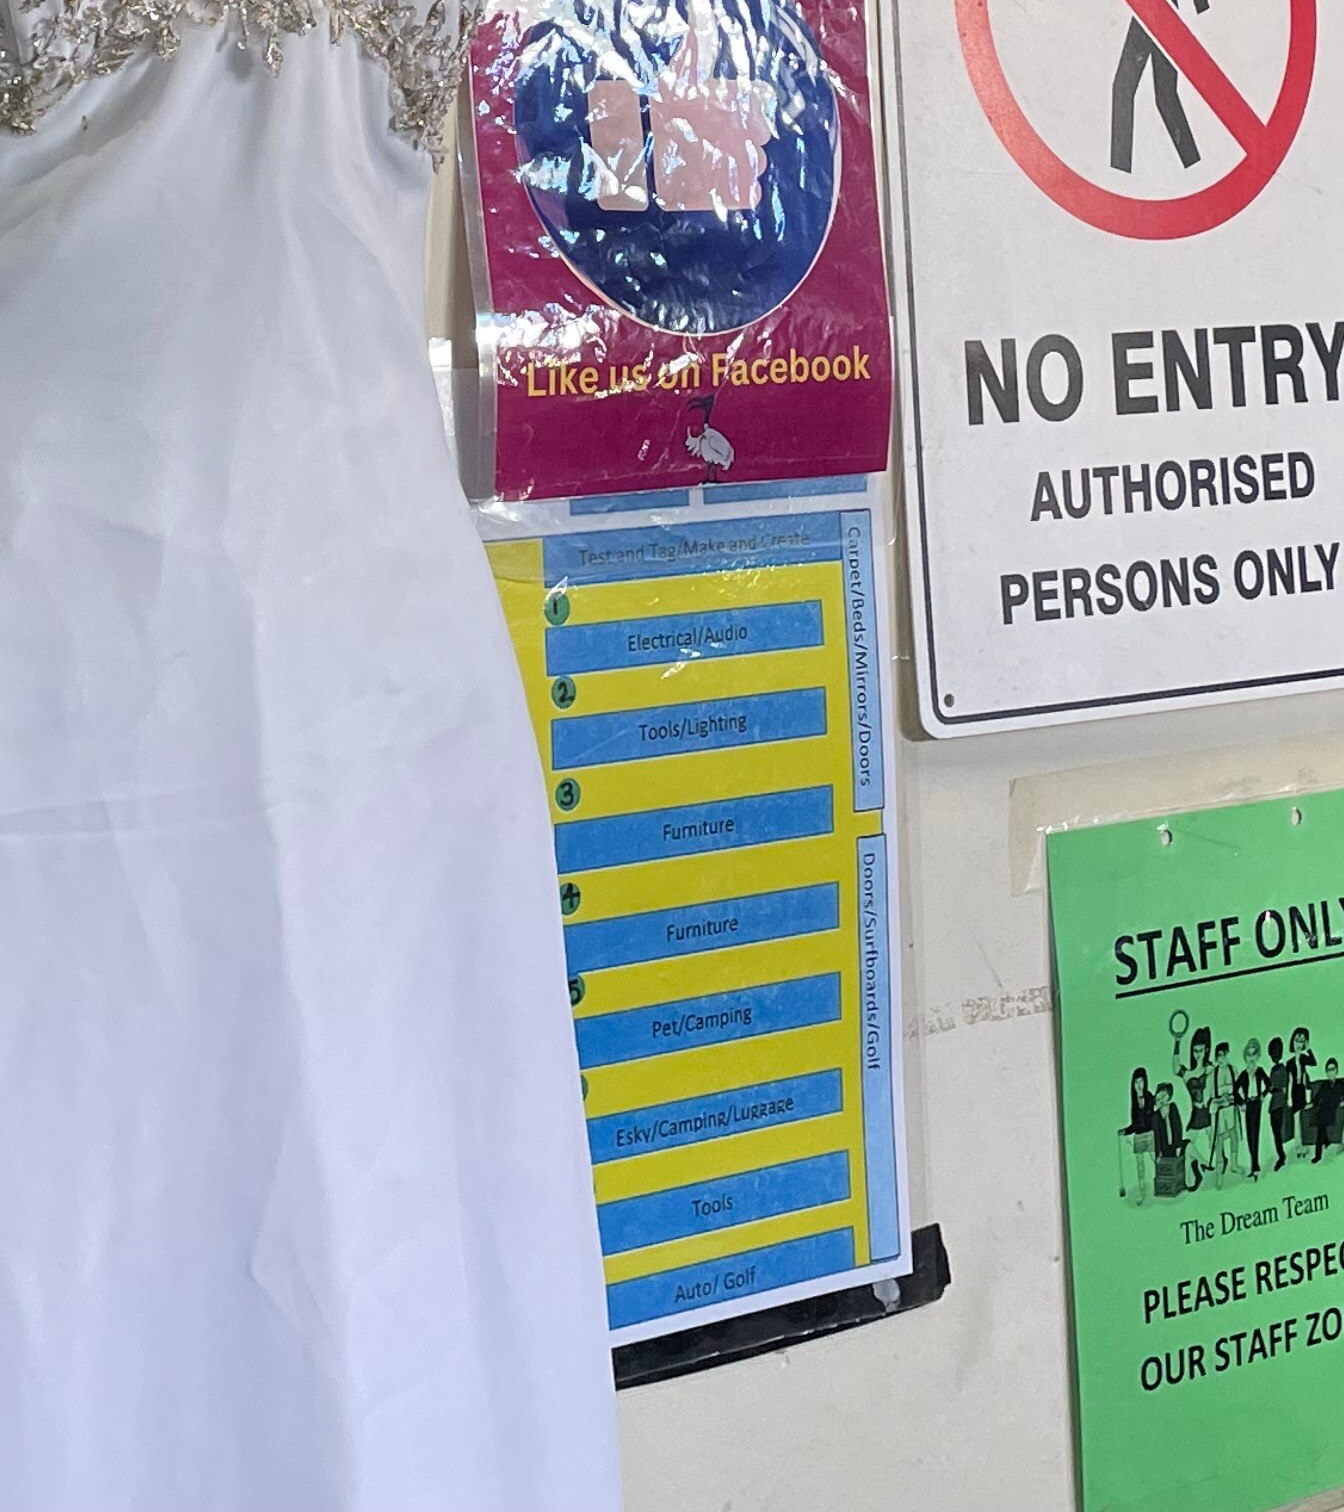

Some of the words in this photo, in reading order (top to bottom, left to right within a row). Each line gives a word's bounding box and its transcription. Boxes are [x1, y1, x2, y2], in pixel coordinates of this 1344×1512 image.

[526, 361, 598, 396] Like
[610, 364, 648, 394] us
[657, 361, 700, 390] on
[711, 346, 870, 387] Facebook
[964, 332, 1085, 426] NO
[1029, 450, 1316, 522] AUTHORISED
[578, 548, 612, 567] Test
[614, 546, 645, 565] and
[1000, 553, 1221, 626] PERSONS
[1233, 541, 1341, 601] ONLY
[627, 624, 748, 653] Electrical/Audio
[846, 525, 872, 787] Carpet/Beds/Mirrors/Doors
[556, 678, 576, 703] 2
[638, 713, 748, 743] Tools/Lighting
[559, 780, 576, 806] 3
[662, 816, 736, 842] Furniture
[561, 884, 581, 909] 4
[665, 916, 739, 943] Furniture
[1114, 915, 1241, 986] STAFF
[862, 852, 882, 1072] Doors/Surfboards/Golf
[652, 1004, 753, 1040] Pet/Camping
[615, 1094, 796, 1149] Esky/Camping/Luggage
[691, 1193, 734, 1219] Tools
[1179, 1219, 1216, 1245] The
[1219, 1206, 1280, 1237] Dream
[1282, 1193, 1329, 1220] Team
[674, 1279, 720, 1304] Auto/
[722, 1264, 757, 1292] Golf
[1143, 1265, 1247, 1325] PLEASE
[1140, 1344, 1207, 1392] OUR
[1214, 1318, 1298, 1372] STAFF
